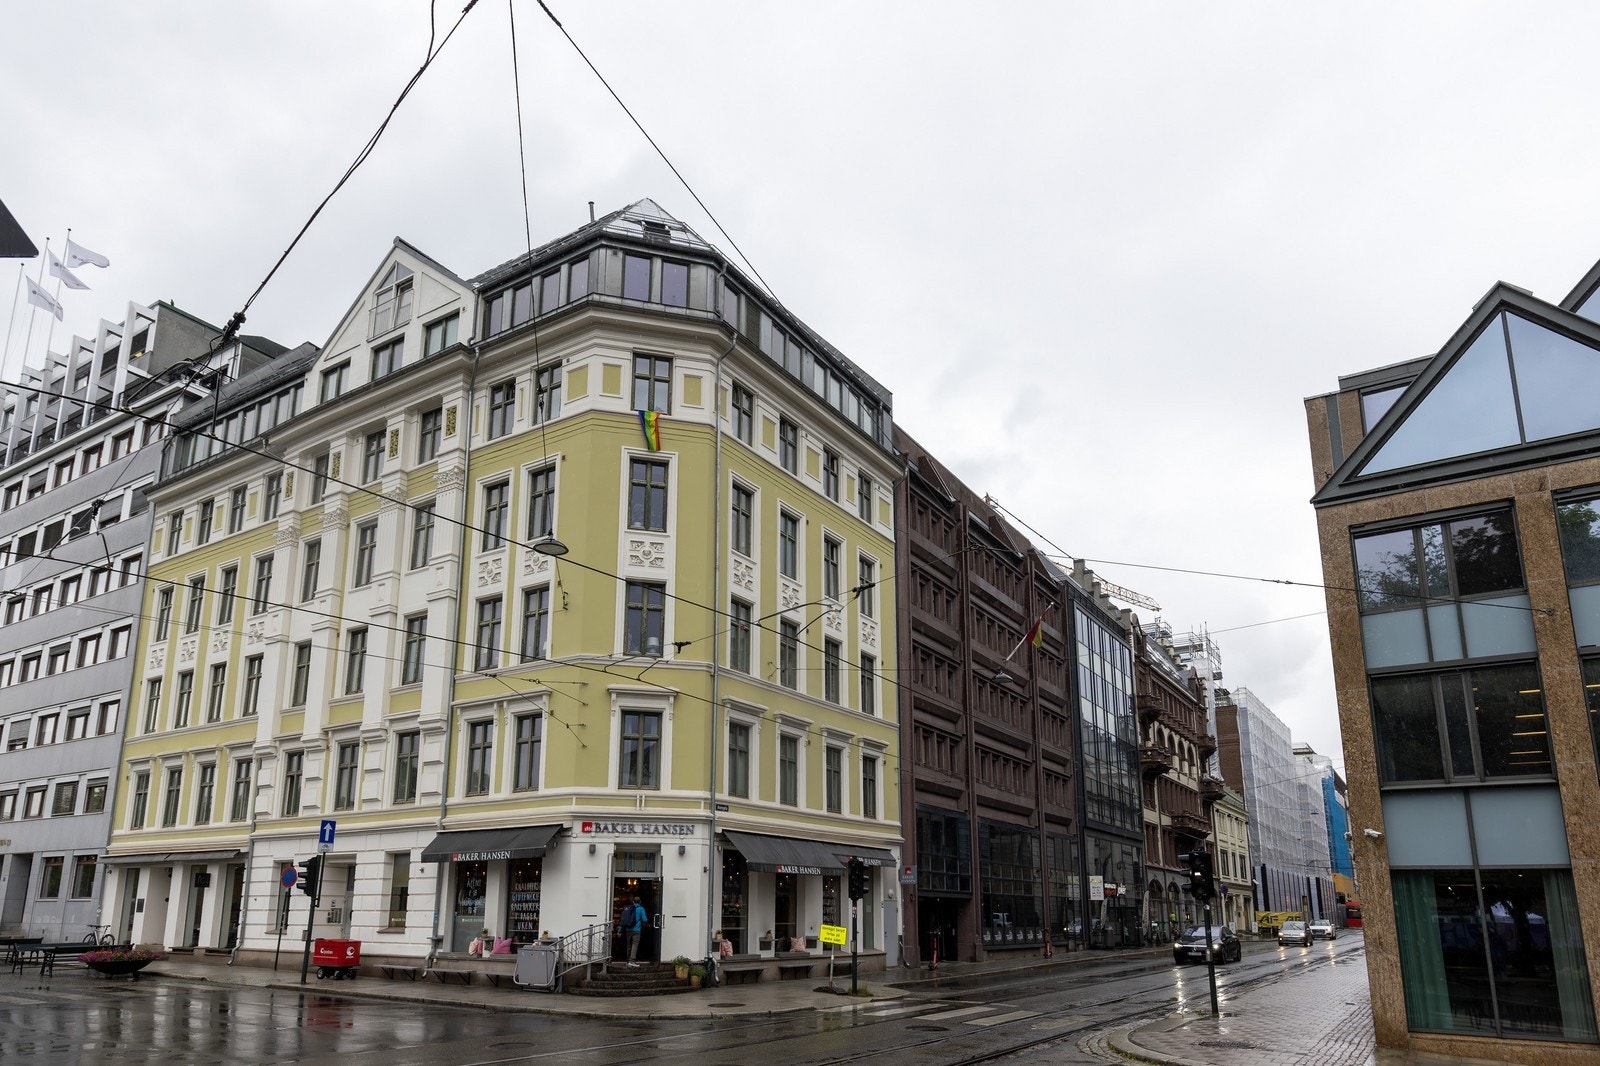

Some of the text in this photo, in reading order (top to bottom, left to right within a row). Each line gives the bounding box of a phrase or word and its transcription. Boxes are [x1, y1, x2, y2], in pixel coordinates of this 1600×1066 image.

[594, 822, 695, 835] BAKER HANSEN
[458, 850, 511, 861] BAKER HANSEN
[781, 865, 821, 875] BAKER HANSEN
